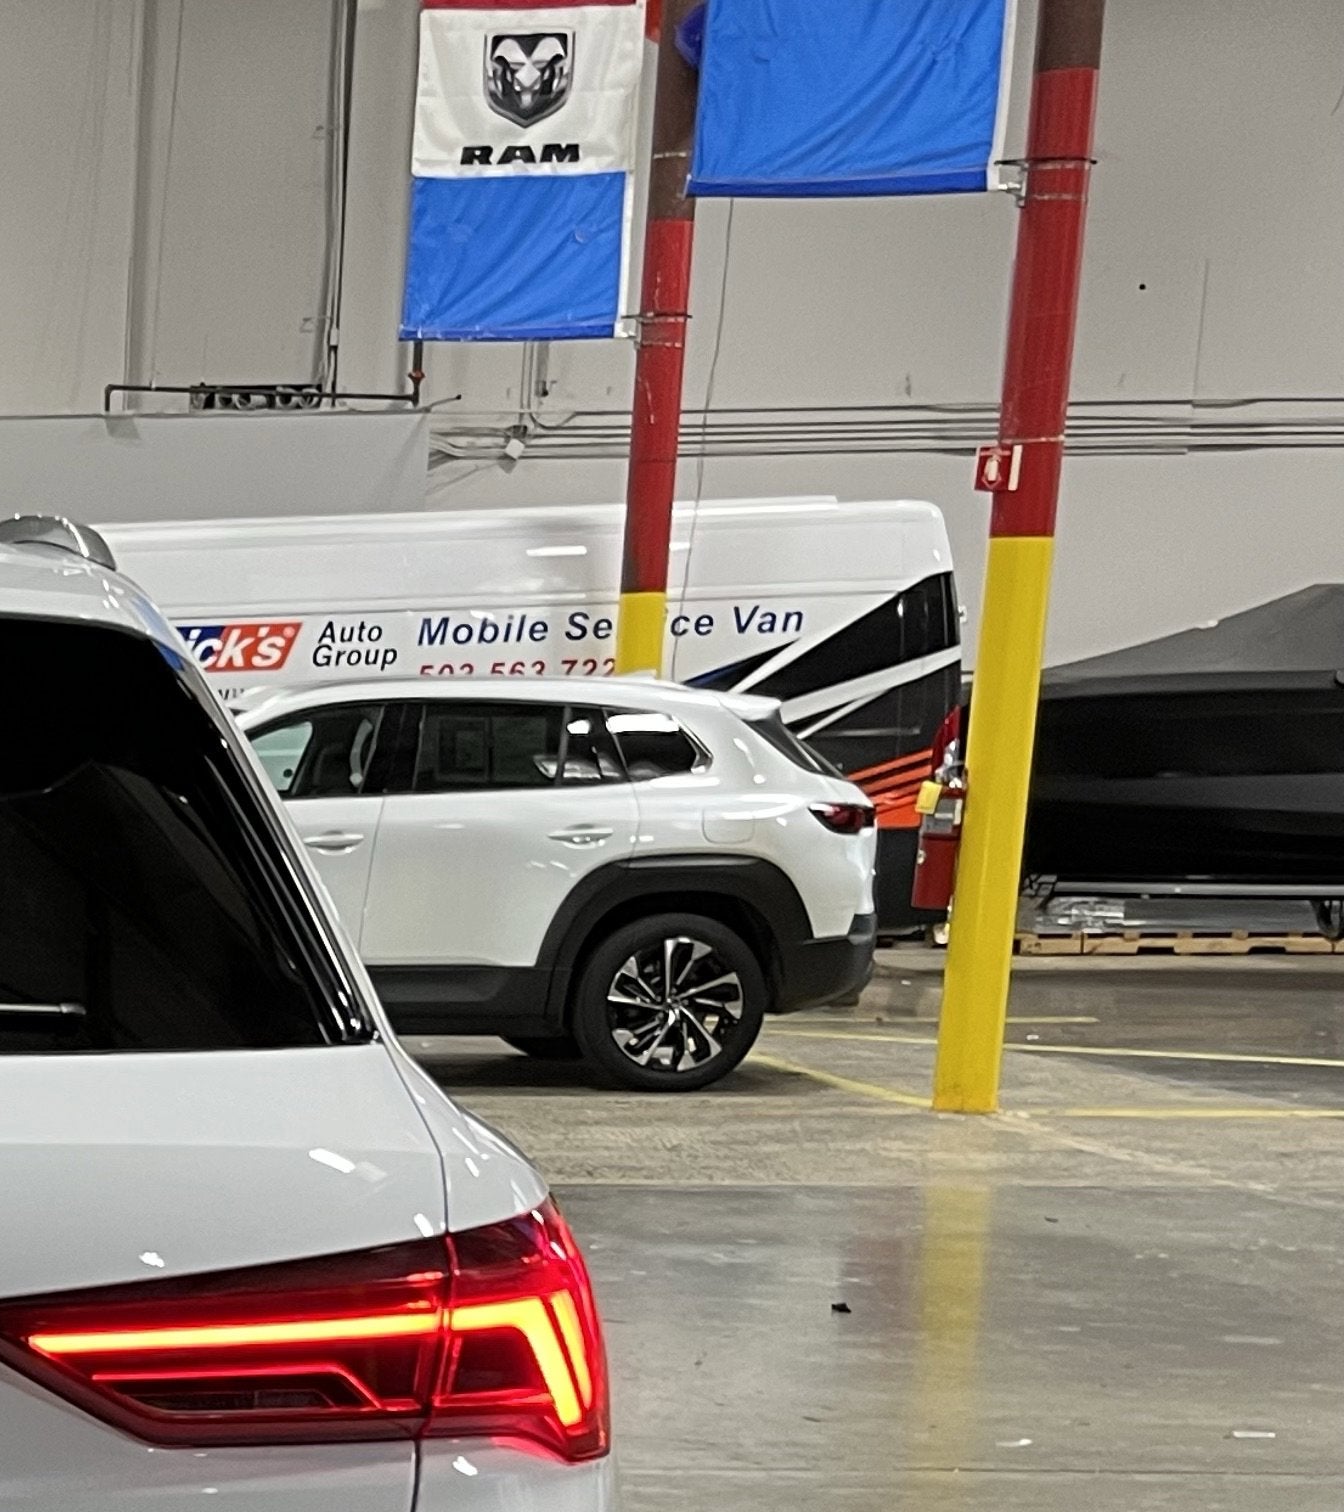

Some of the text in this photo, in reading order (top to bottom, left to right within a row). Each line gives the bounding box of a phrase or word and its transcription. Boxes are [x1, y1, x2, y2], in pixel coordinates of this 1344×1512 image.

[460, 143, 581, 166] RAM
[318, 620, 384, 644] Auto
[417, 604, 805, 646] Mobile Sece Van
[312, 644, 398, 671] Group
